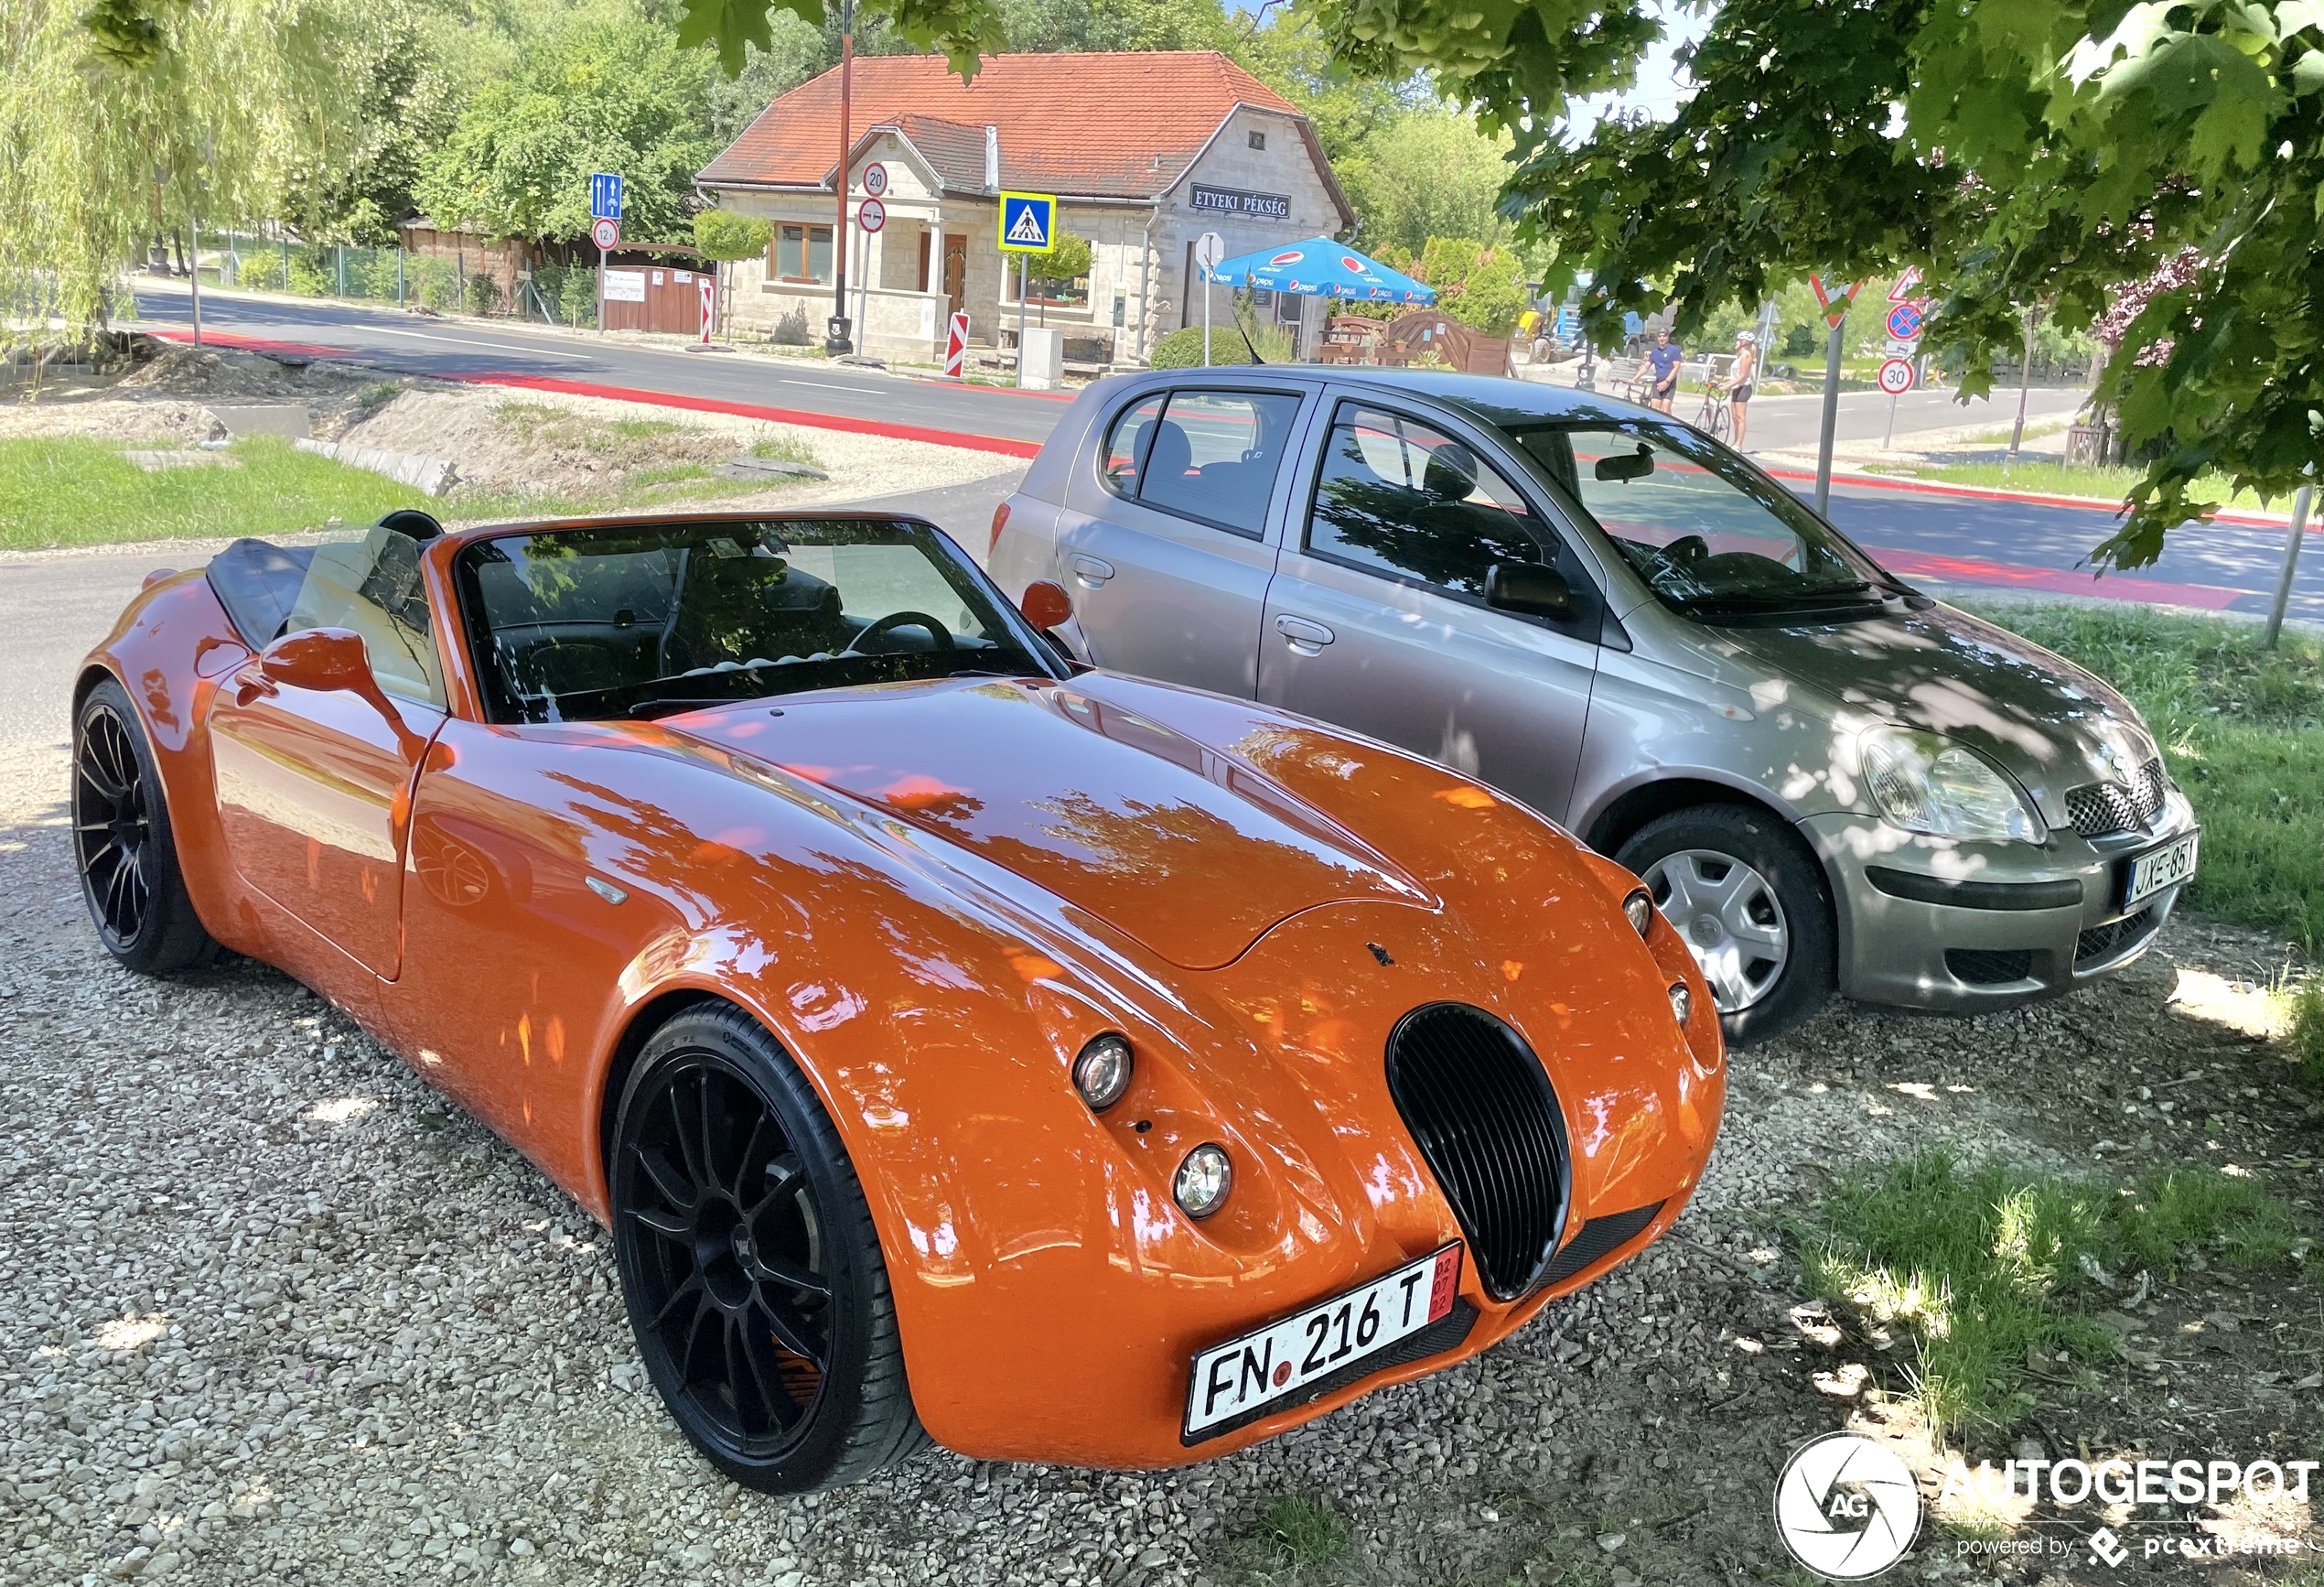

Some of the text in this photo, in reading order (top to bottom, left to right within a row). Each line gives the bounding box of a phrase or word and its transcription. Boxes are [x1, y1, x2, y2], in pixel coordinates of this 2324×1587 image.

[869, 172, 882, 187] 20
[1195, 190, 1286, 215] ETYEKI PÉKSÉG
[599, 229, 608, 240] 12
[1255, 277, 1275, 286] pepsi
[1298, 284, 1318, 293] pepsi
[1341, 287, 1356, 296] pepsi
[1378, 289, 1393, 298] pepsi
[1888, 370, 1905, 384] 30
[2136, 839, 2193, 894] JXE-851
[1434, 1276, 1448, 1295] 07
[1431, 1295, 1446, 1314] 22
[1205, 1270, 1423, 1417] FN 216 T
